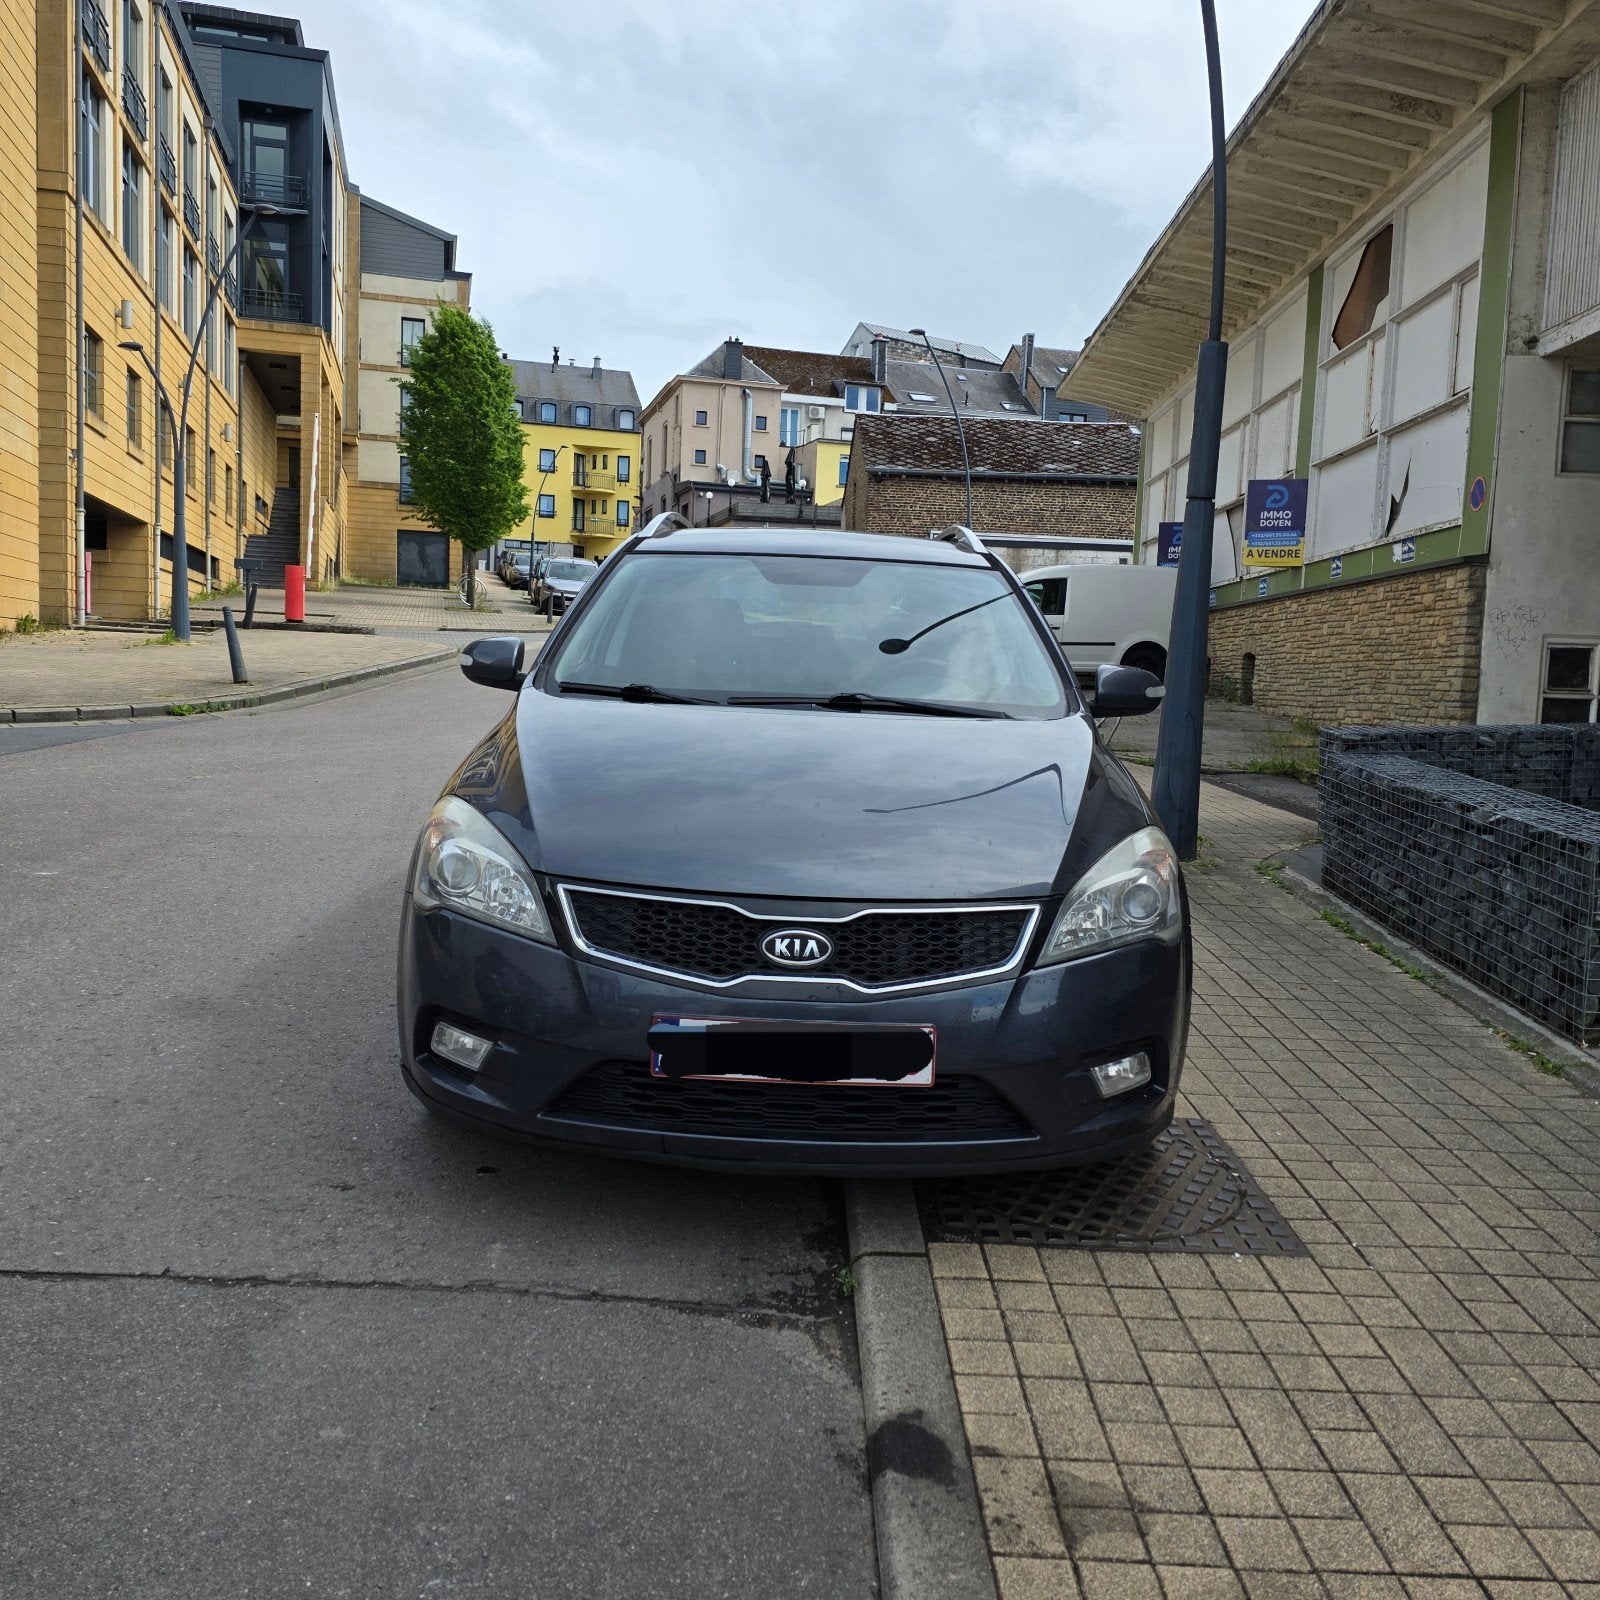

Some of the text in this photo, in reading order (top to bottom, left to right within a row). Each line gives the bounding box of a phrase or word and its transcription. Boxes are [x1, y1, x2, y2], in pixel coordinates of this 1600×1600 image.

[1260, 510, 1292, 519] IMMO
[1260, 519, 1292, 527] DOYEN
[1256, 549, 1301, 558] VENDRE
[774, 938, 820, 958] KIA
